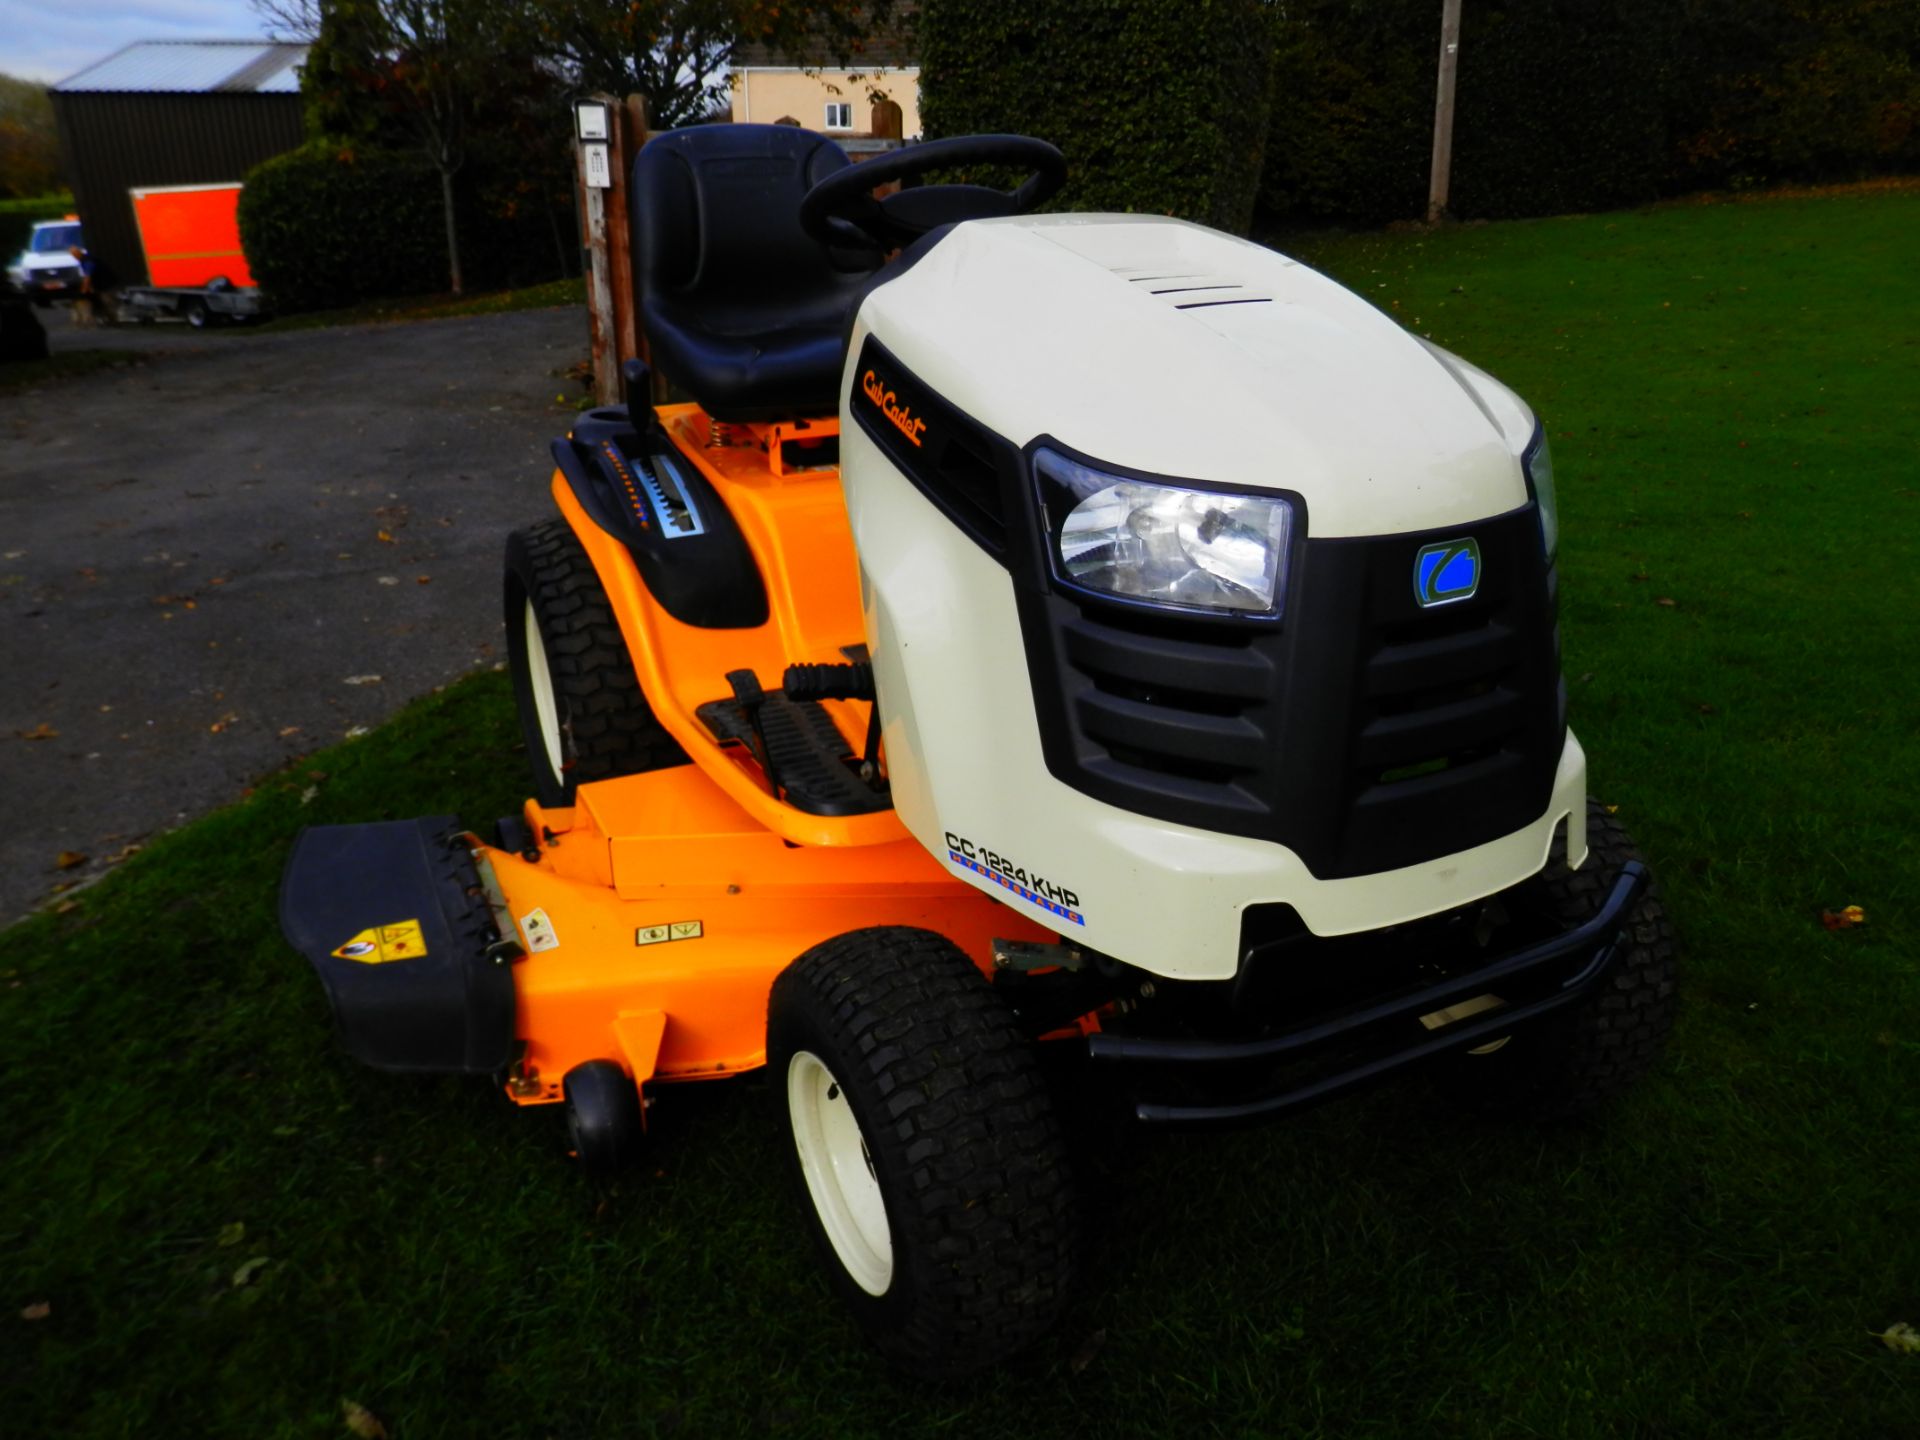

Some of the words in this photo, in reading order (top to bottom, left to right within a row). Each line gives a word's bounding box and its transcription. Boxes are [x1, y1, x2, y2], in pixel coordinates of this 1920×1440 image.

[863, 370, 883, 407] Cub
[882, 391, 926, 447] Cadet
[945, 831, 976, 859] CC
[978, 847, 1029, 887] 1224
[1030, 873, 1080, 907] KHP
[952, 853, 1080, 922] HYDROSTATIC
